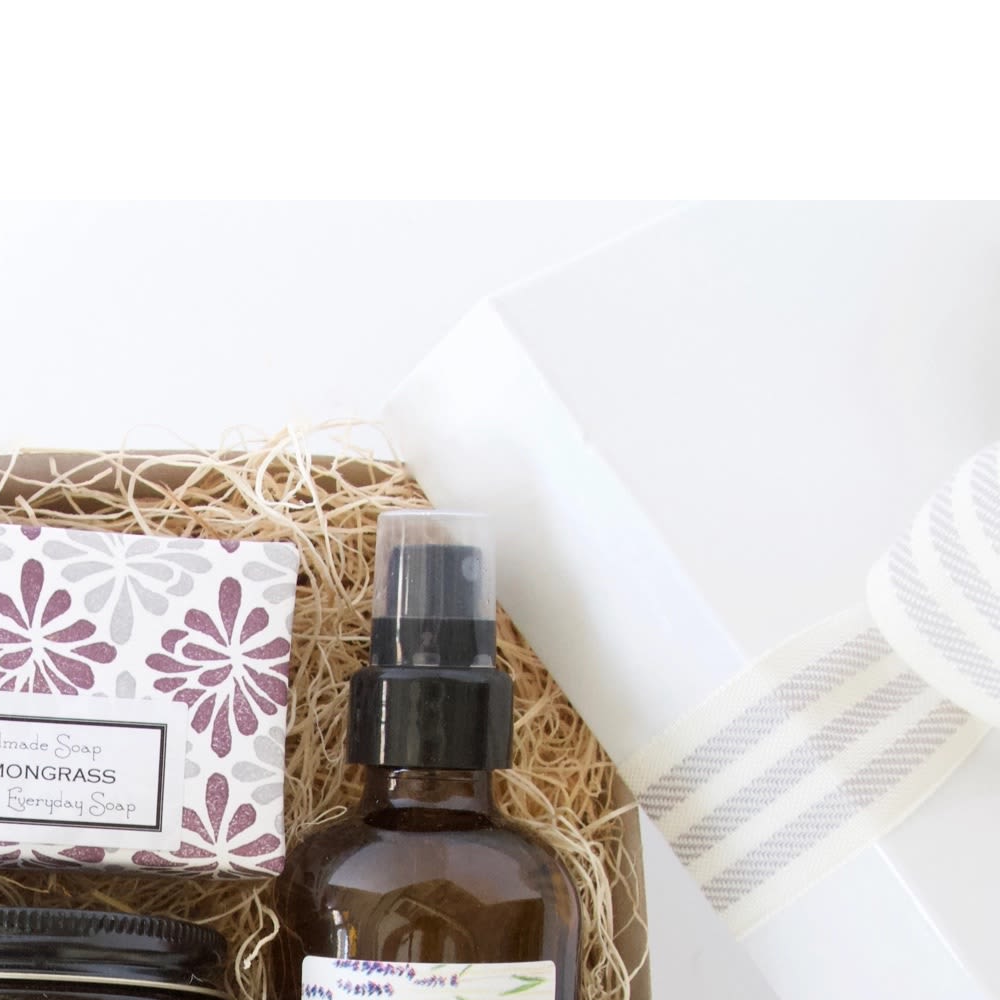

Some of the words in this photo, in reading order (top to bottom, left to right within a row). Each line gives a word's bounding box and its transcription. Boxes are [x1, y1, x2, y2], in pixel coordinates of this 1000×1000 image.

[54, 734, 102, 761] Soap
[7, 787, 84, 814] Everyday
[88, 791, 136, 819] Soap
